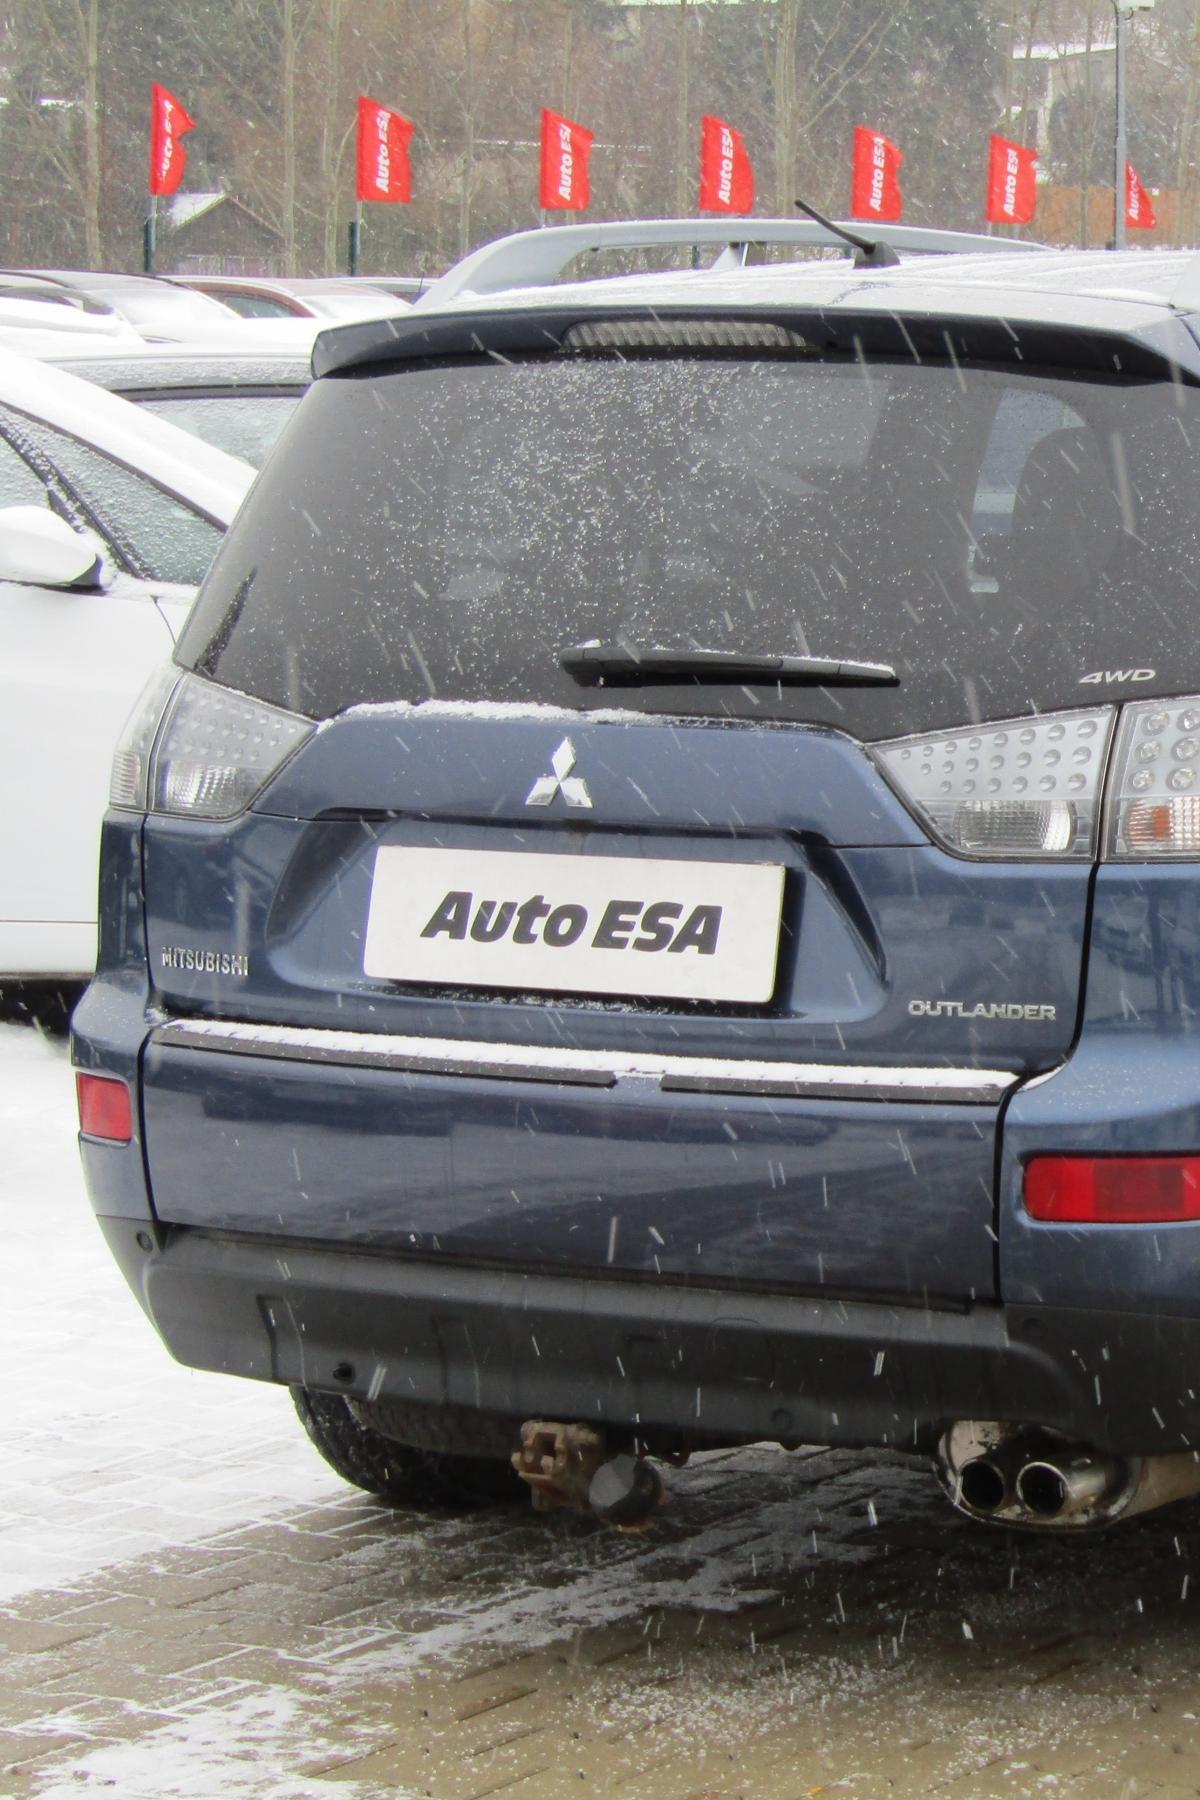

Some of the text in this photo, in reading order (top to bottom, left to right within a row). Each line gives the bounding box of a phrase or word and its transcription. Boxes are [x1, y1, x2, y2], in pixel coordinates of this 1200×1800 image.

[375, 143, 389, 193] Auto
[558, 152, 572, 201] Auto
[718, 159, 732, 205] Auto
[869, 168, 884, 212] Auto
[1003, 174, 1016, 217] Auto
[1079, 668, 1156, 685] 4WD
[419, 890, 723, 956] Auto ESA
[162, 946, 249, 977] MITSUBISHI
[908, 1000, 1057, 1021] OUTLANDER
